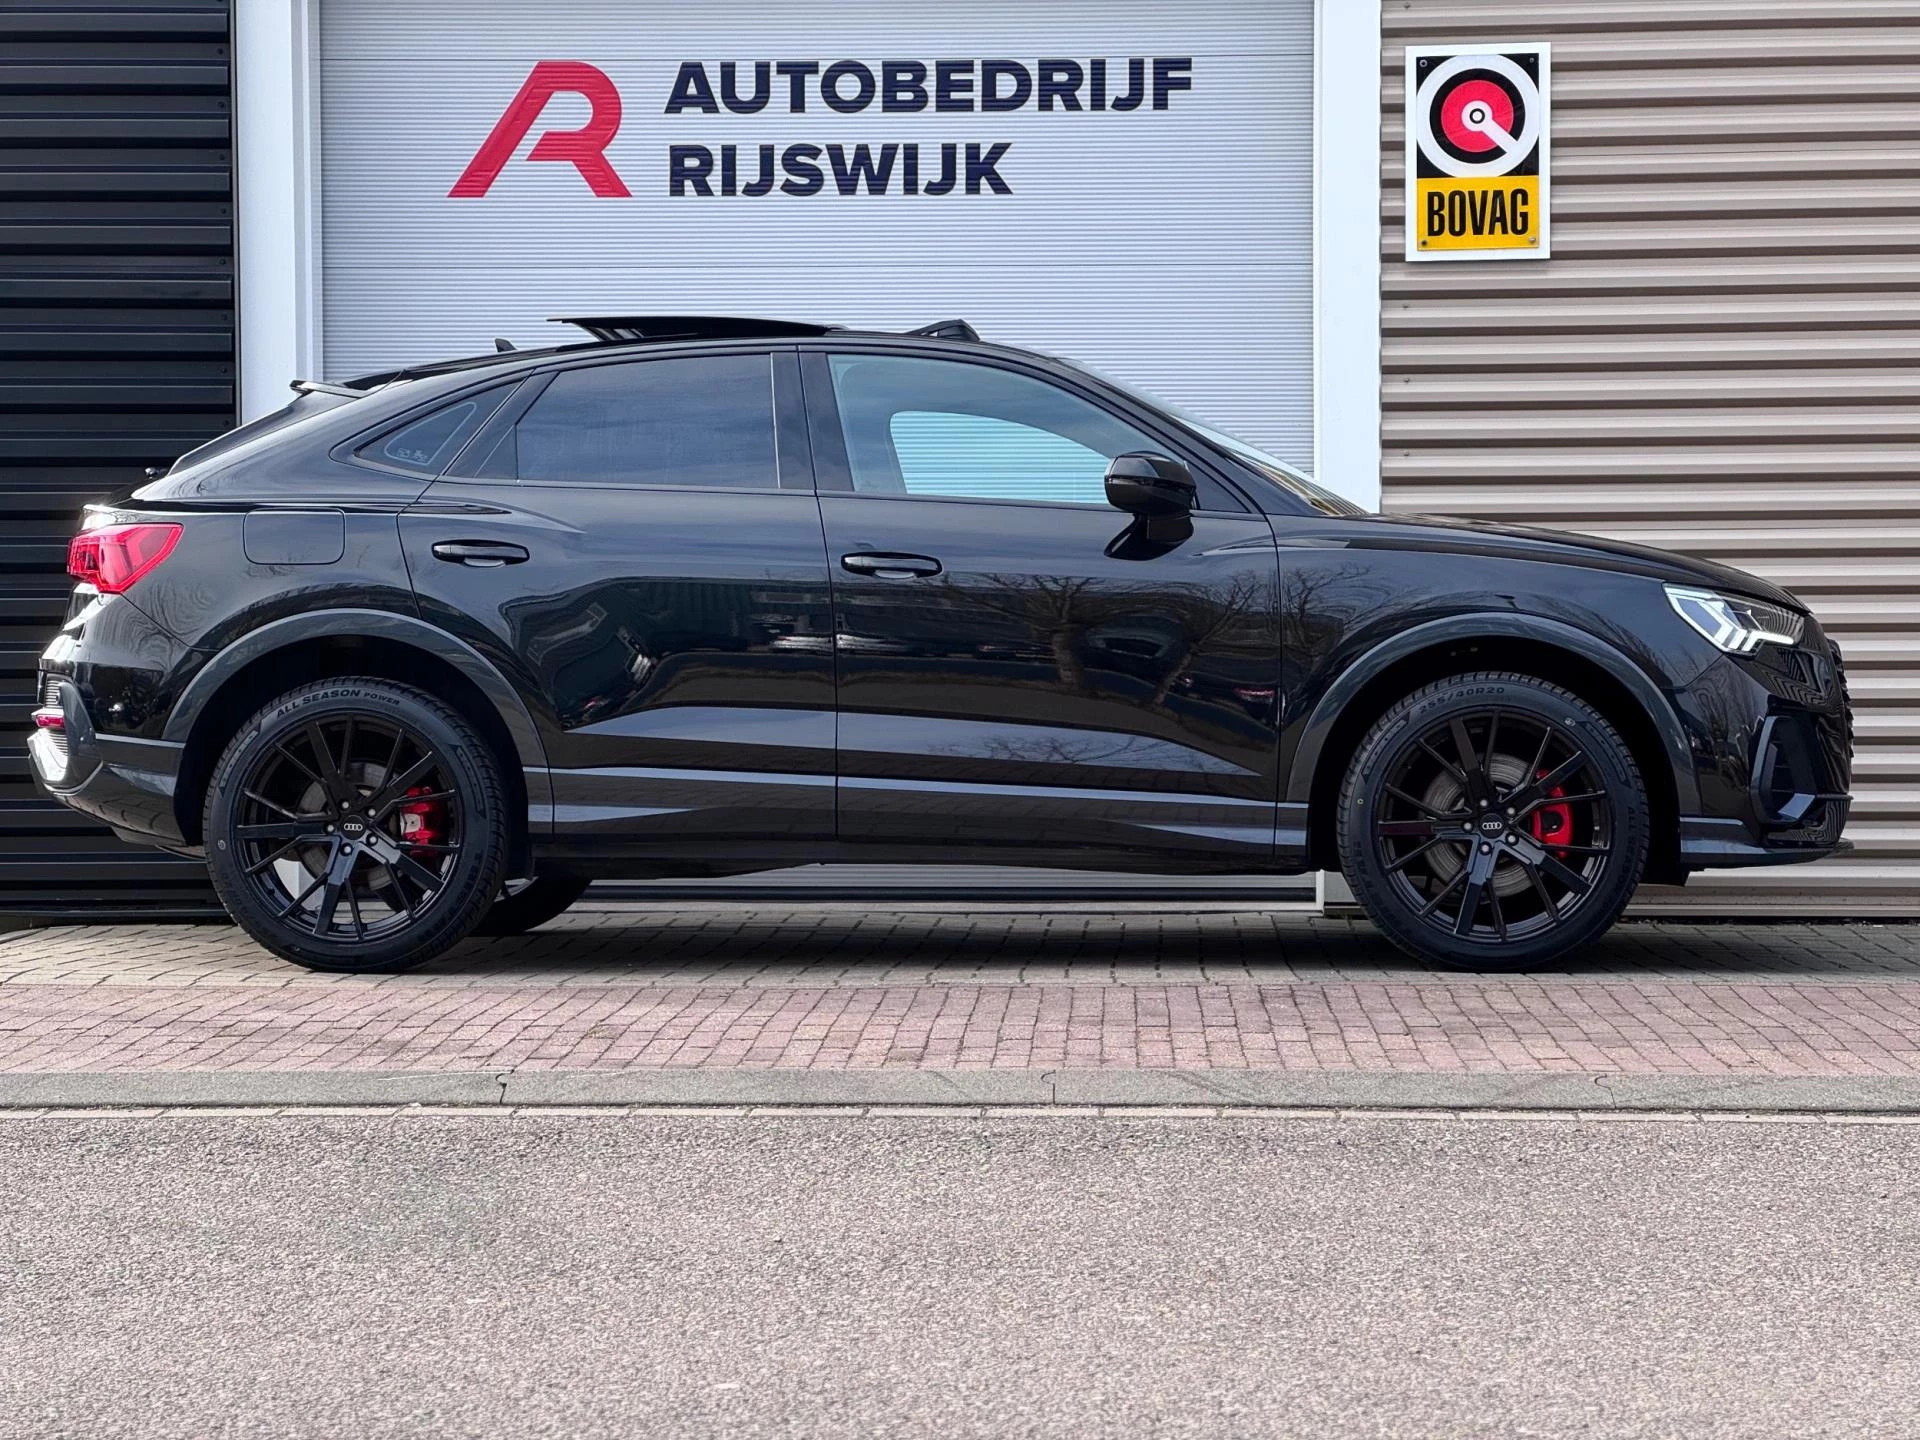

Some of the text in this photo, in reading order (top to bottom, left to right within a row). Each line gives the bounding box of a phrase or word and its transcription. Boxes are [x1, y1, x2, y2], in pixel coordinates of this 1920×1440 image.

[664, 57, 1193, 115] AUTOBEDRIJF
[668, 142, 1013, 197] RIJSWIJK
[1427, 188, 1529, 237] BOVAG
[277, 689, 400, 718] ALL SEASON POWER
